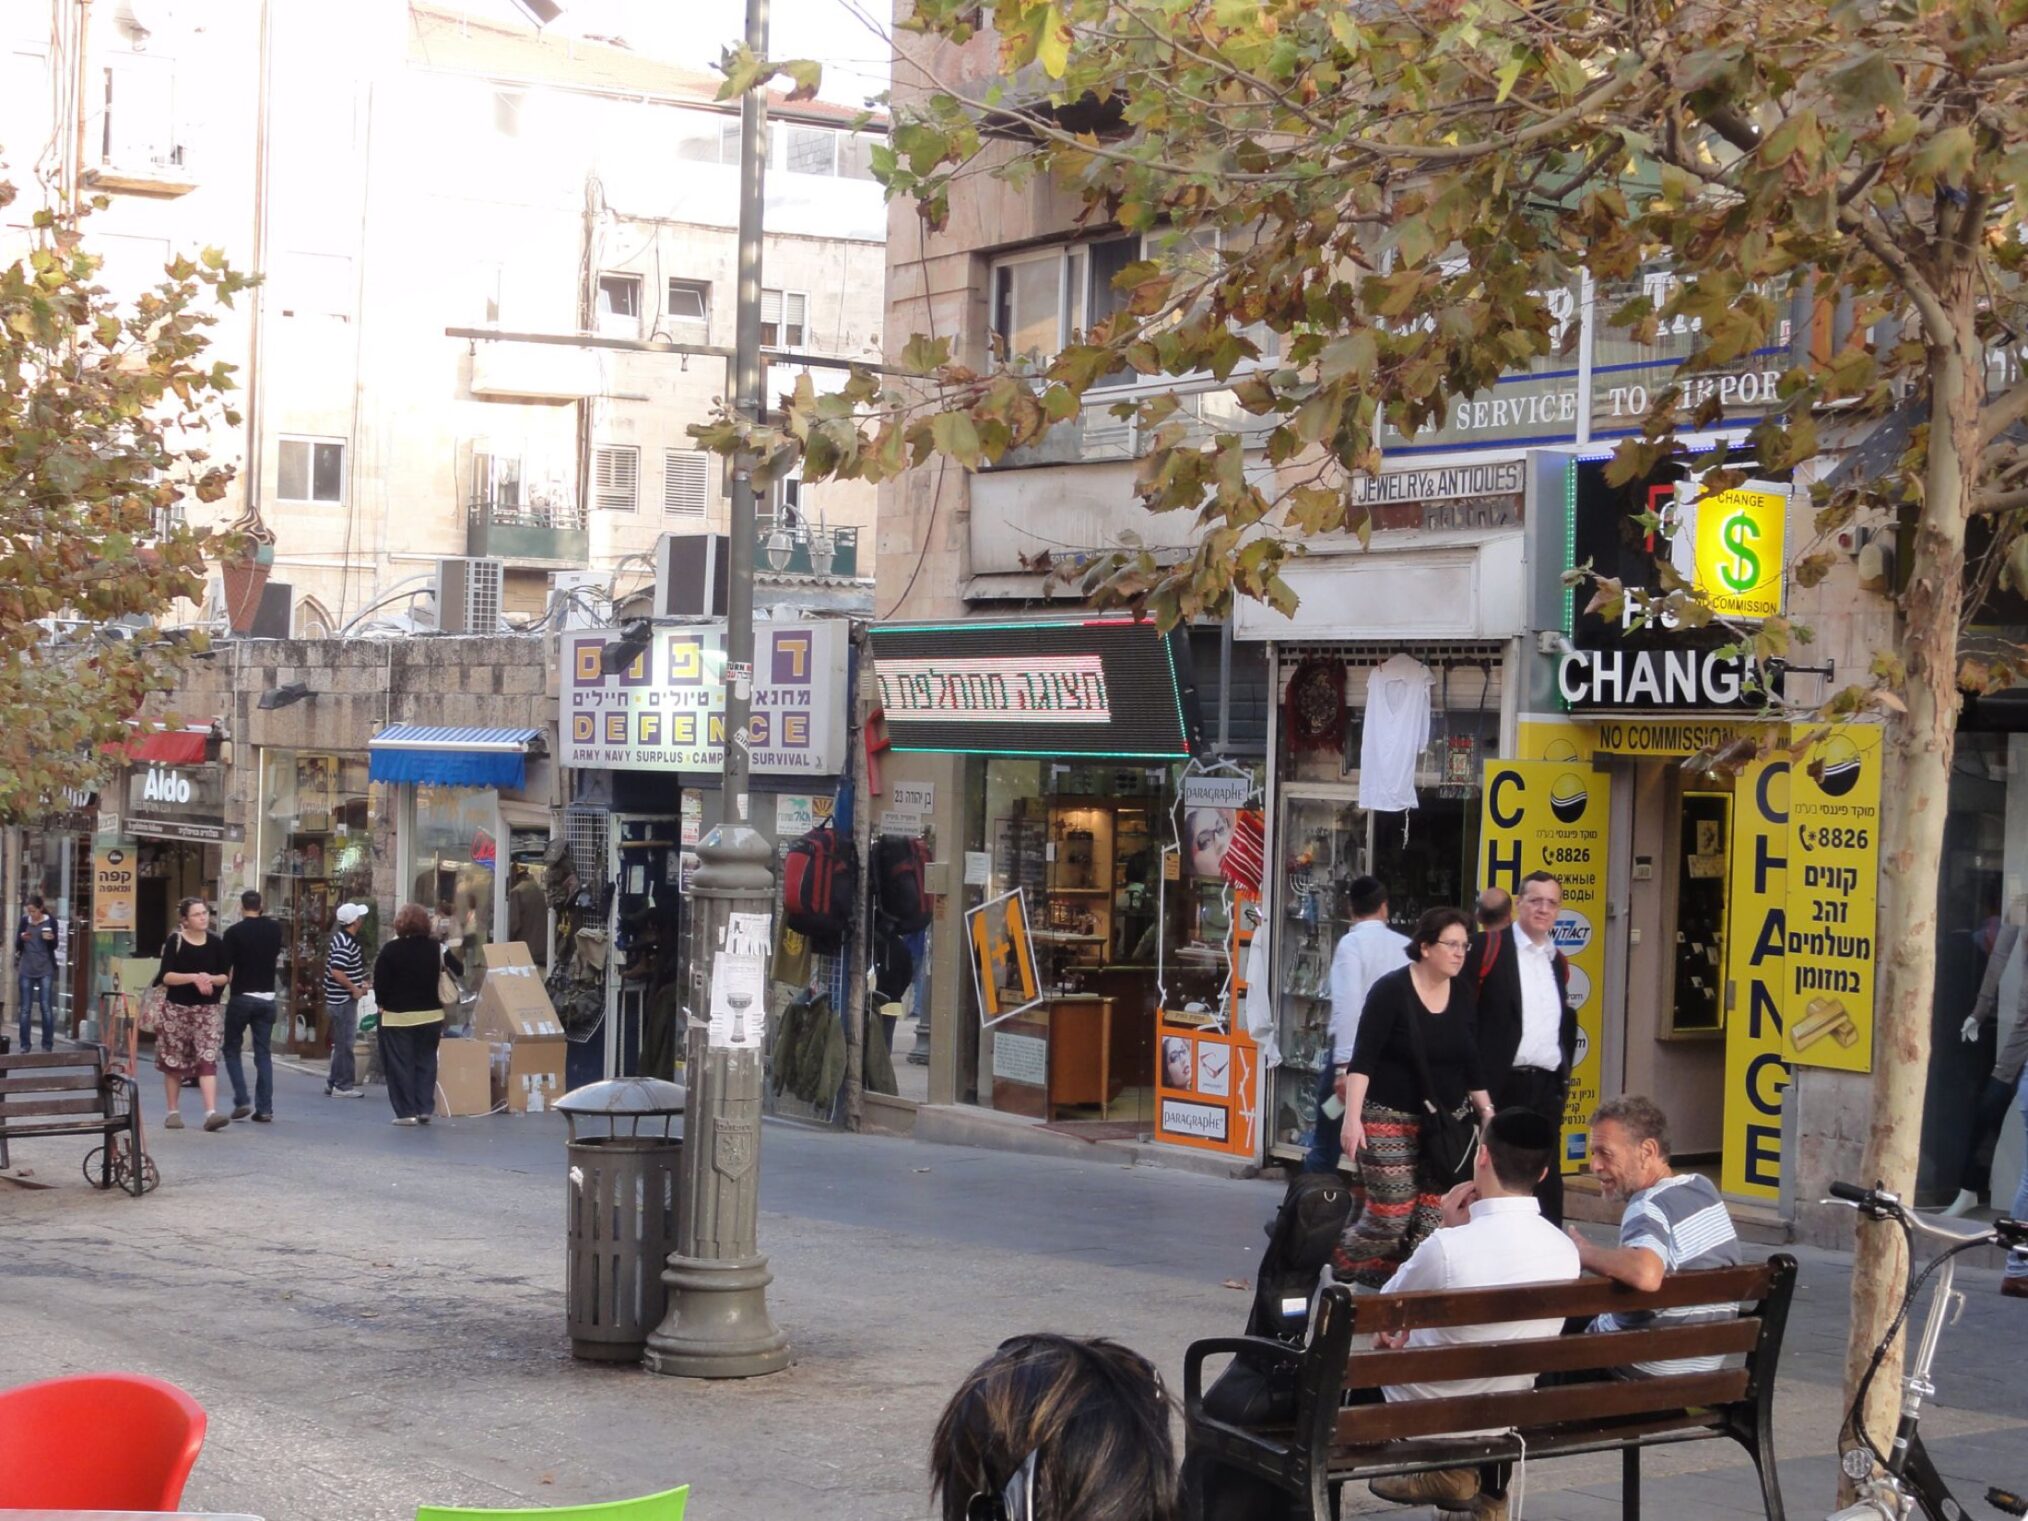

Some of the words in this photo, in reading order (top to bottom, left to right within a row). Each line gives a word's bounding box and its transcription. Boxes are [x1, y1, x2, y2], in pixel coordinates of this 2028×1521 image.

[1456, 393, 1576, 431] SERVICE
[1609, 385, 1647, 416] TO
[1437, 464, 1518, 497] ANTIQUES
[1717, 492, 1765, 508] CHANGE
[1712, 597, 1777, 615] COMMISSION
[572, 690, 629, 707] חיילים
[649, 690, 709, 706] טיולים
[1016, 671, 1106, 710] תצוגה
[574, 712, 808, 745] DEFENCE
[1600, 726, 1622, 750] NO
[1627, 725, 1735, 751] COMMISSION
[573, 750, 600, 761] ARMY
[605, 751, 631, 762] NAVY
[636, 751, 683, 764] SURPLUS
[752, 753, 810, 767] SURVIVAL
[143, 768, 191, 803] Aldo
[894, 790, 904, 801] 23
[905, 791, 923, 804] יהודה
[924, 792, 932, 806] בן
[1818, 805, 1849, 816] פיננסי
[1850, 806, 1875, 818] מוקד
[99, 870, 131, 884] קפה
[1804, 865, 1857, 897] קונים
[98, 884, 131, 893] ומאפה
[1812, 899, 1848, 924] זהב
[1788, 926, 1870, 961] משלמים
[973, 897, 1036, 1016] 1+1
[1795, 965, 1861, 995] במזומן
